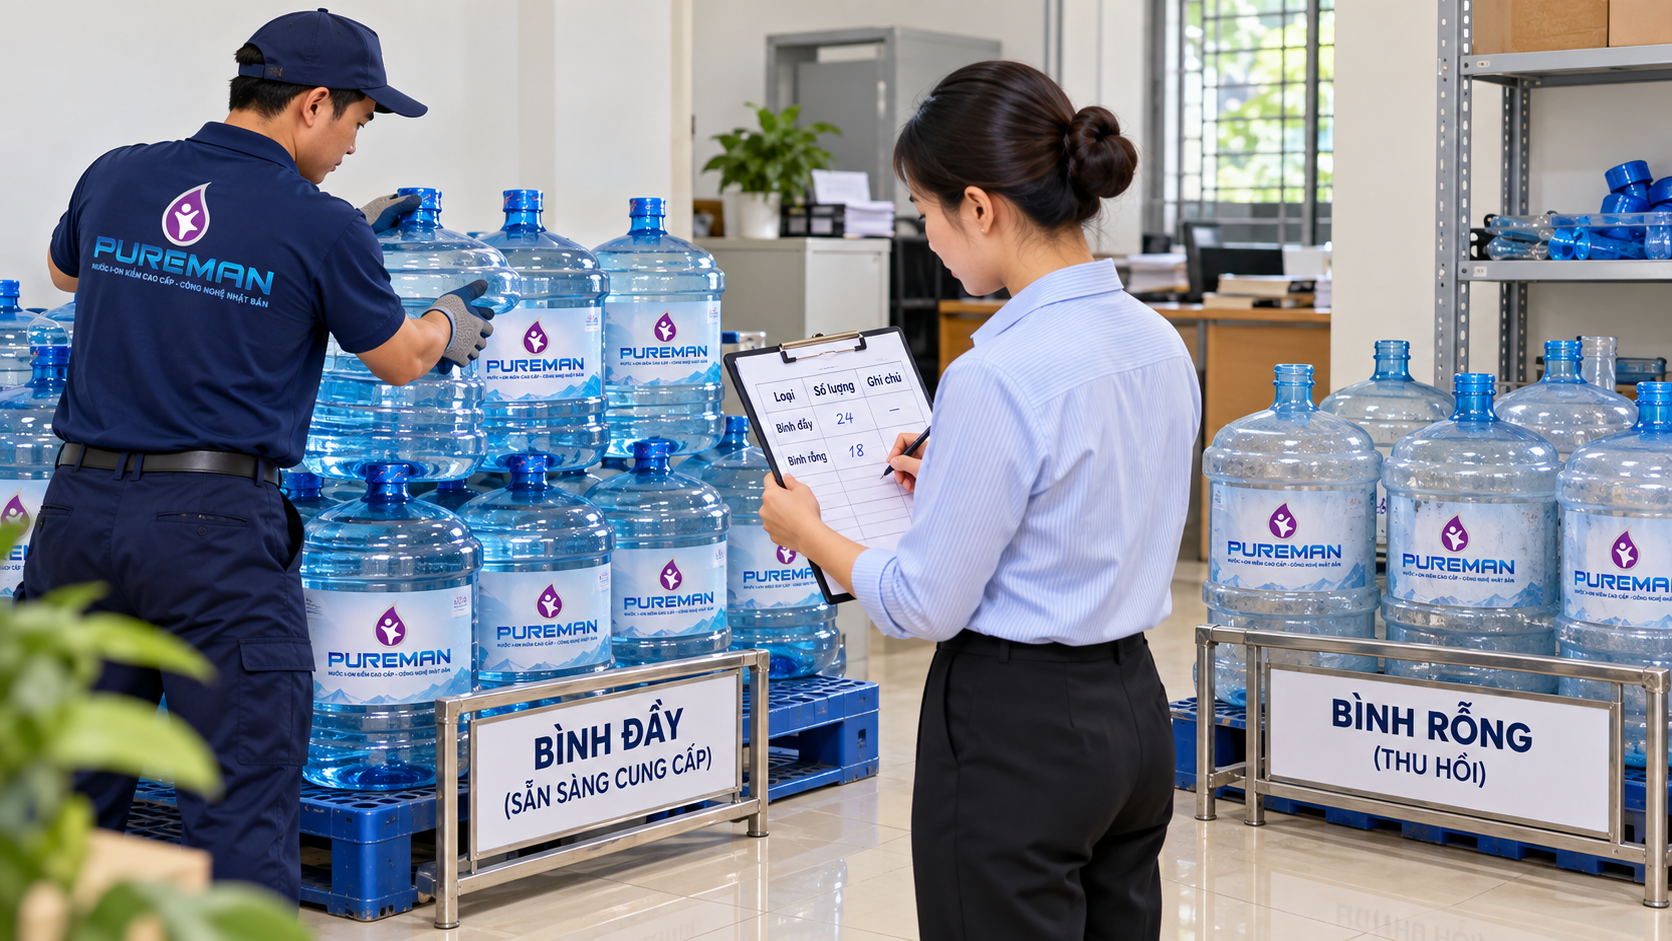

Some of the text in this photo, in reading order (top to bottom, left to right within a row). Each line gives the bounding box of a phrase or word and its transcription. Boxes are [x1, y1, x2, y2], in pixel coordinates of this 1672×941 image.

[94, 236, 274, 295] PUREMAN
[142, 273, 158, 282] CAO
[620, 345, 708, 359] PUREMAN
[486, 357, 584, 373] PUREMAN
[813, 382, 855, 396] Số lượng
[867, 374, 884, 387] Ghi
[773, 389, 796, 403] Loại
[836, 412, 853, 425] 24
[849, 443, 864, 458] 18
[1228, 540, 1341, 559] PUREMAN
[1403, 553, 1515, 574] PUREMAN
[743, 567, 814, 583] PUREMA
[1574, 570, 1672, 593] PUREMA
[624, 591, 714, 610] PUREMAN
[497, 619, 598, 640] PUREMAN
[328, 648, 451, 668] PUREMAN
[1332, 692, 1533, 753] BÌNH RỖNG
[534, 698, 684, 770] BÌNH ĐẦY
[1374, 745, 1486, 788] (THU HỒI)
[504, 743, 712, 820] (SẴN SÀNG CUNG CẤP)
